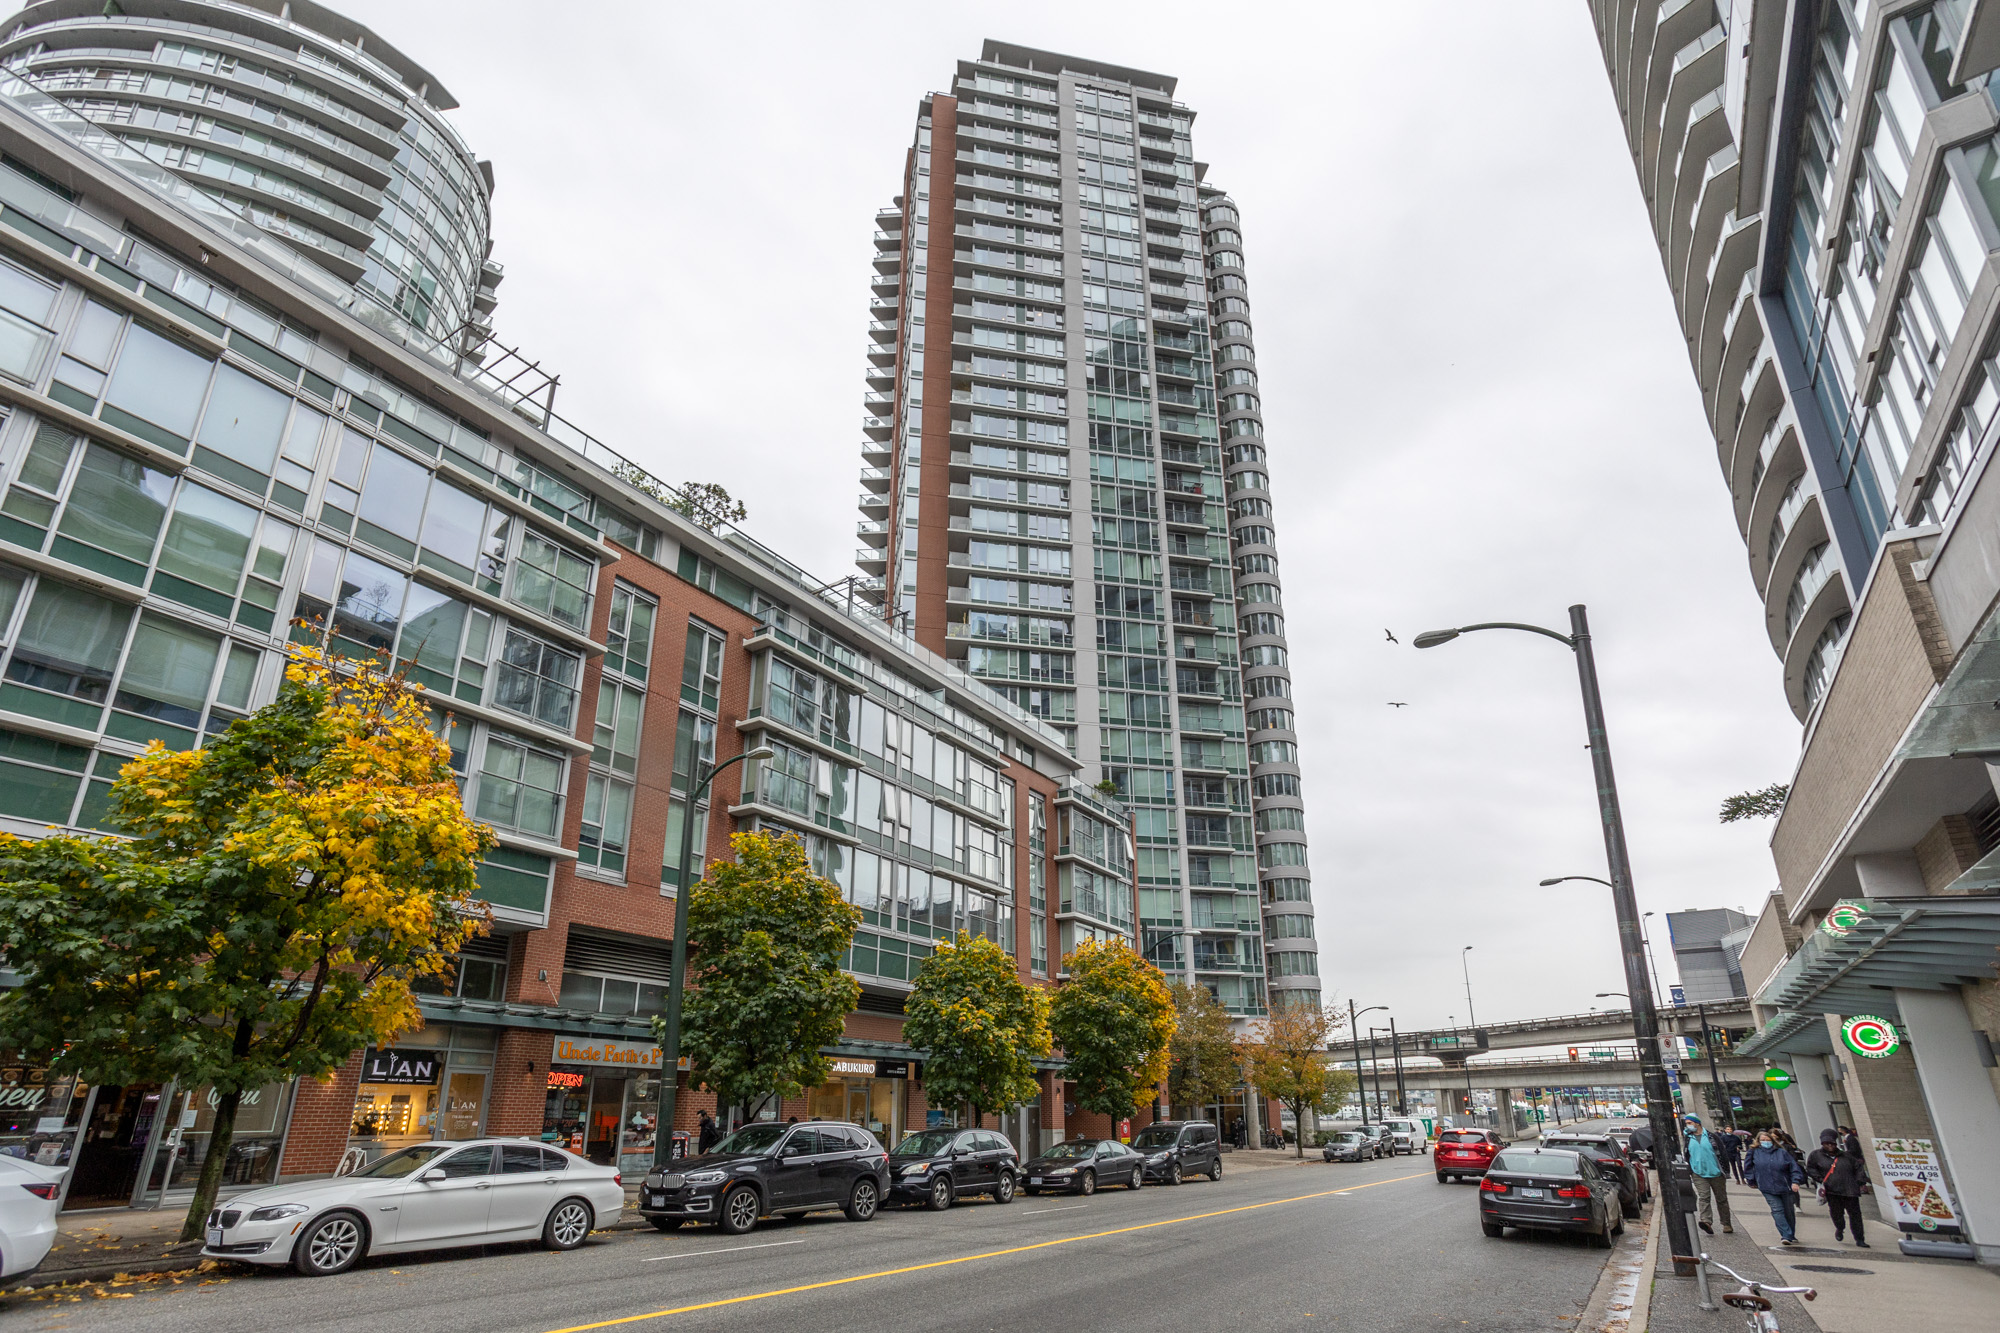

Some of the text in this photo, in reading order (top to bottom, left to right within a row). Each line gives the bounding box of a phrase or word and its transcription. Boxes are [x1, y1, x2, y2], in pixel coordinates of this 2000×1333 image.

[558, 1041, 600, 1061] Uncle
[604, 1044, 649, 1064] Fatih's
[1862, 1051, 1891, 1059] PIZZA
[371, 1052, 433, 1077] LIAN
[547, 1072, 584, 1087] OPEN
[1917, 1171, 1939, 1182] 4.98
